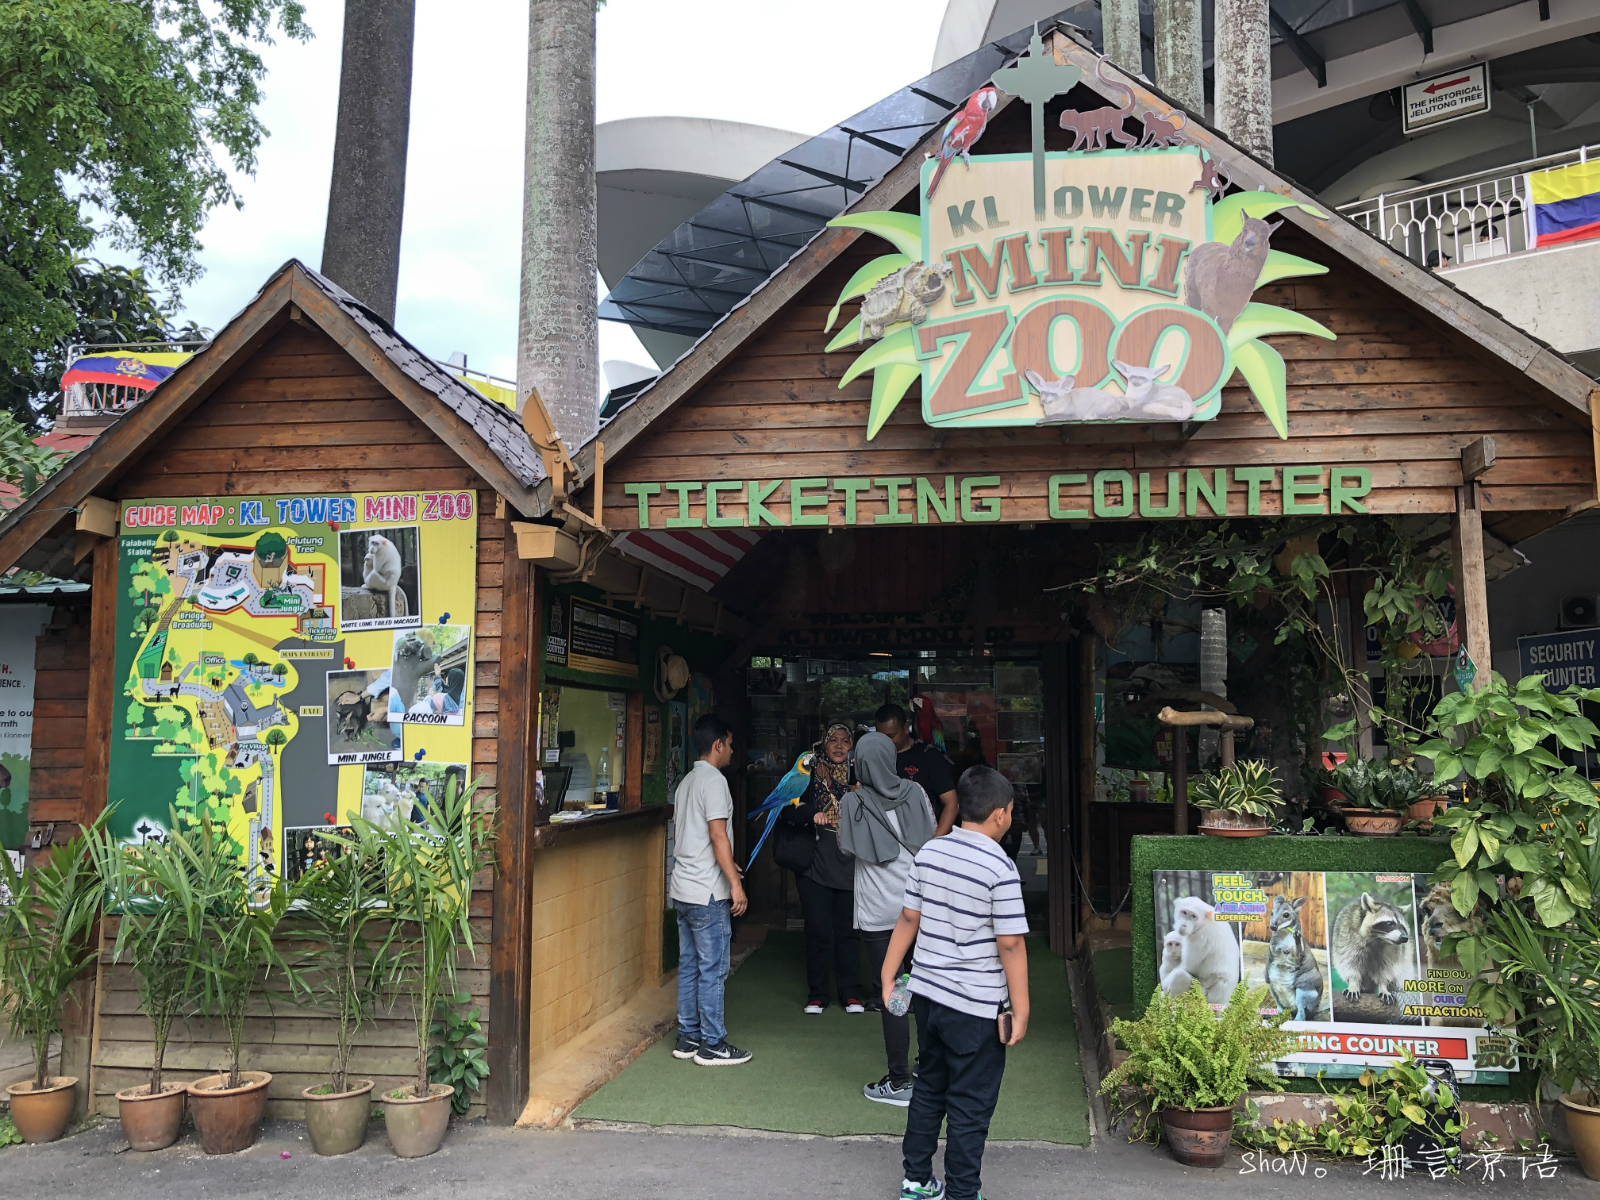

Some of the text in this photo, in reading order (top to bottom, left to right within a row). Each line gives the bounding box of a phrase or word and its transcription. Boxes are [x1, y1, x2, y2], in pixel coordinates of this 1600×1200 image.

[1409, 85, 1483, 110] THE HISTORICAL
[1410, 92, 1483, 118] JELUTONG TREE
[946, 195, 1010, 238] KL
[943, 226, 1194, 307] MINI
[912, 294, 1231, 424] ZOO
[625, 466, 1373, 529] TICKETING COUNTER
[125, 505, 178, 527] GUIDE
[181, 504, 225, 525] MAP
[239, 500, 270, 525] KL
[276, 497, 357, 524] TOWER
[364, 496, 418, 522] MINI
[421, 493, 474, 521] ZOO
[121, 539, 156, 547] Falabella
[127, 548, 152, 556] Stable
[296, 545, 316, 554] Tree
[280, 605, 305, 613] Jungle
[180, 612, 205, 621] Bridge
[394, 617, 420, 625] MACAQUE
[172, 620, 213, 631] Broadway
[308, 628, 337, 636] Ticketing
[1529, 639, 1595, 665] SECURITY
[204, 656, 226, 664] Office
[403, 713, 448, 724] RACCOON
[250, 743, 269, 751] Village
[337, 752, 392, 763] MINI JUNGLE
[1212, 874, 1253, 889] FEEL.
[1375, 875, 1410, 883] RACCOON
[1213, 889, 1268, 904] TOUCH.
[1214, 904, 1266, 913] A RELAXING
[1214, 914, 1263, 922] EXPERIENCE.
[1427, 969, 1450, 979] FIND
[1404, 979, 1464, 993] MORE ON
[1433, 995, 1456, 1005] OUR
[1346, 1036, 1440, 1056] COUNTER
